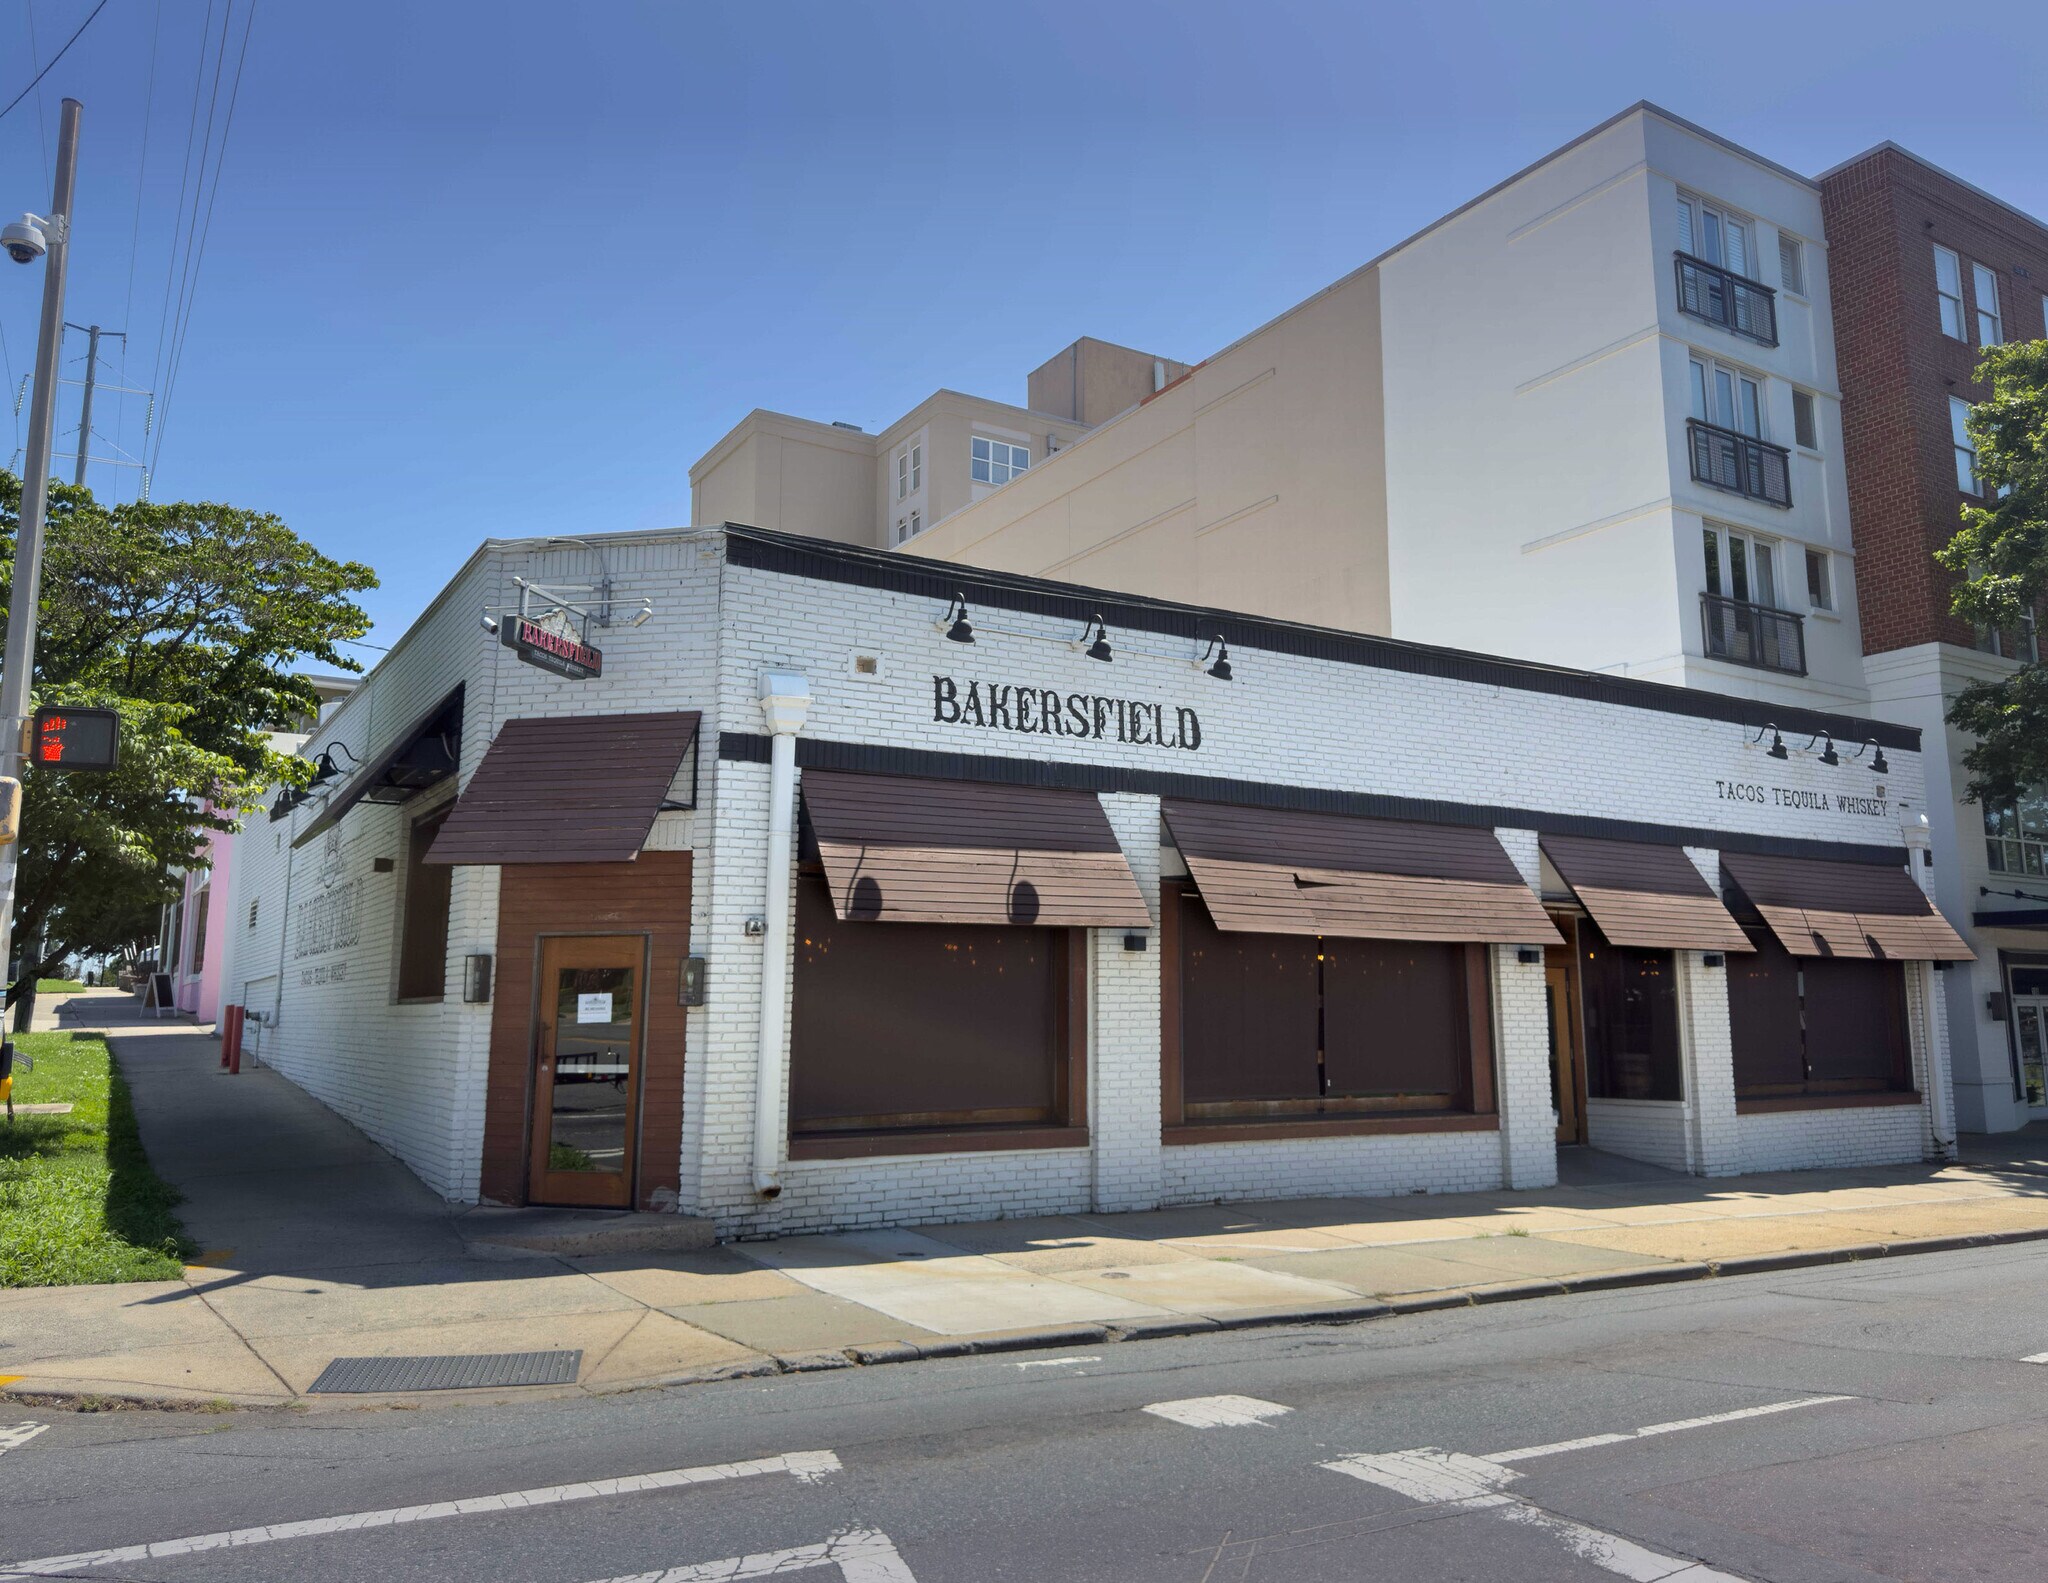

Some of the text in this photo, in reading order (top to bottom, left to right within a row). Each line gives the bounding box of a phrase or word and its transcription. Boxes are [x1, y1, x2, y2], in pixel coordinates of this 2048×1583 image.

[522, 622, 601, 669] BAKERSFIELD
[933, 675, 1201, 750] BAKERSFIELD
[1716, 781, 1887, 817] TACOS TEQUILA WHISKEY
